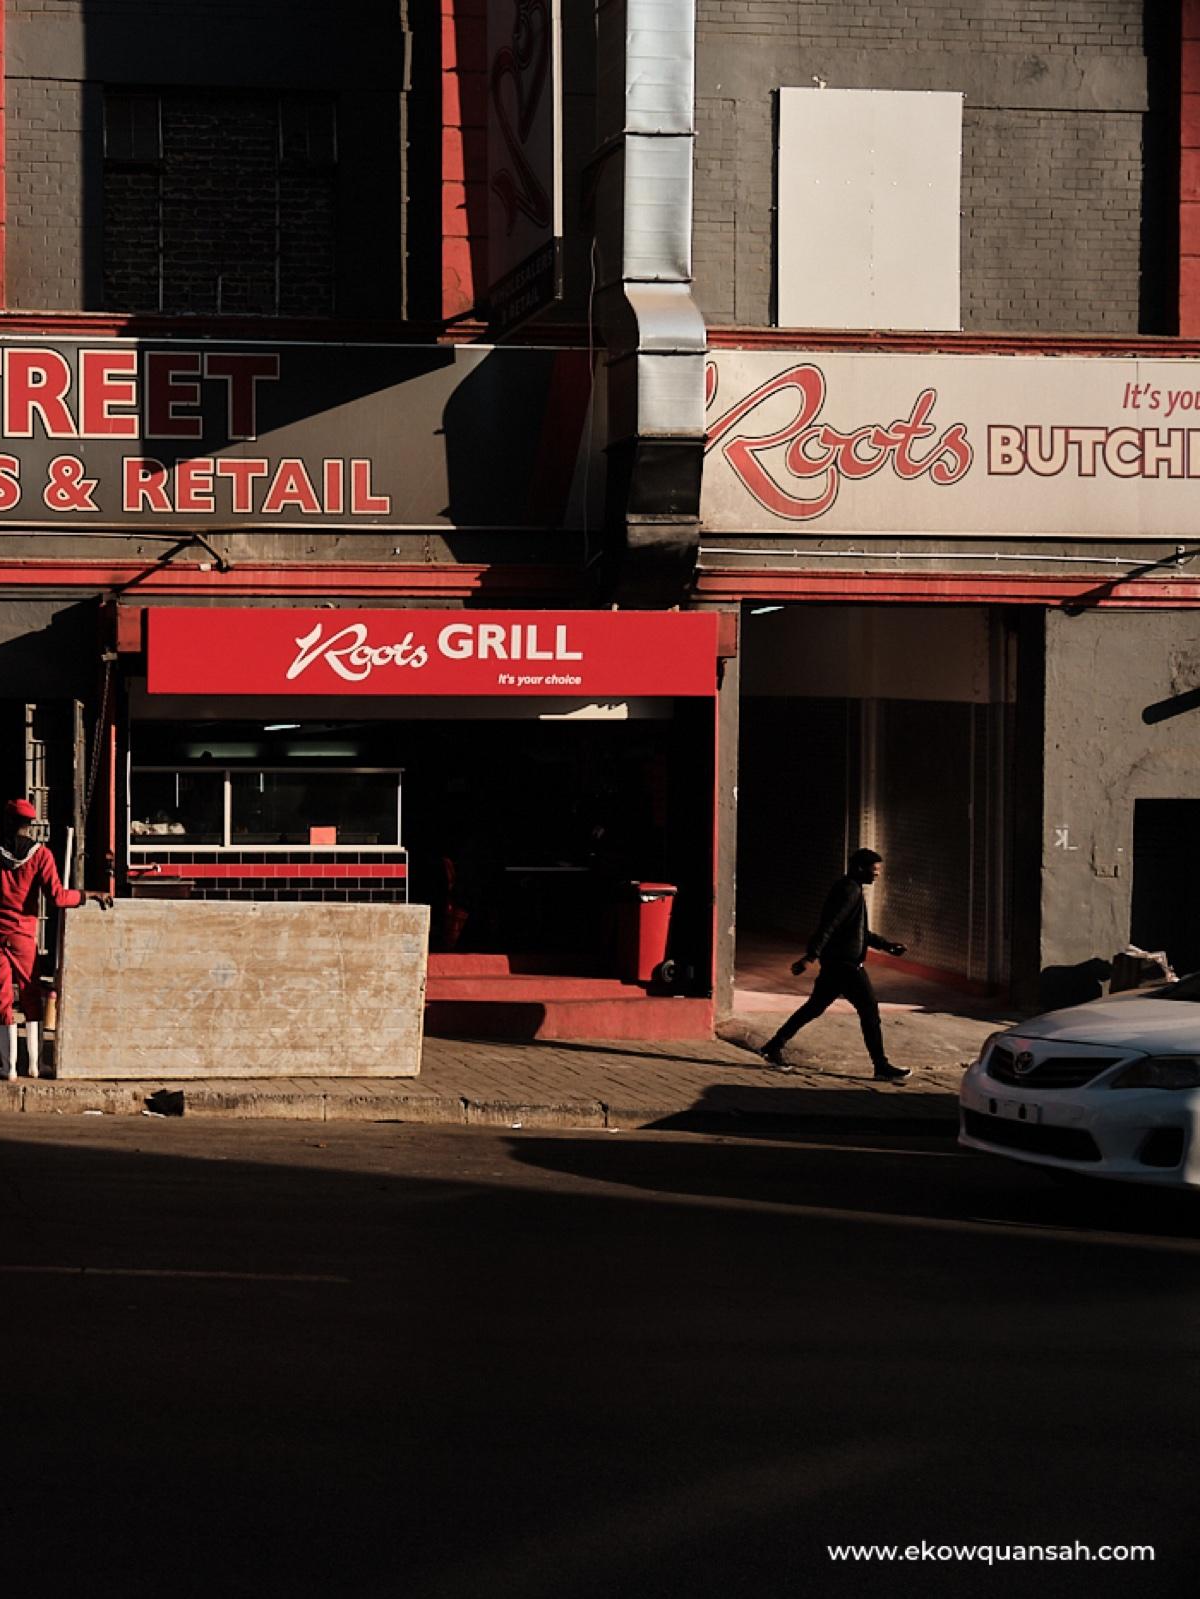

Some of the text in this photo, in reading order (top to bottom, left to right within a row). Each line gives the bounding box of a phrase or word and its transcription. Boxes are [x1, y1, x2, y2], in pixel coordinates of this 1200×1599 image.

[1122, 382, 1161, 410] It's
[704, 361, 974, 522] Roots
[42, 454, 100, 513] &
[121, 456, 392, 517] RETAIL
[286, 622, 584, 682] Roots GRILL
[498, 673, 582, 687] It's your choice
